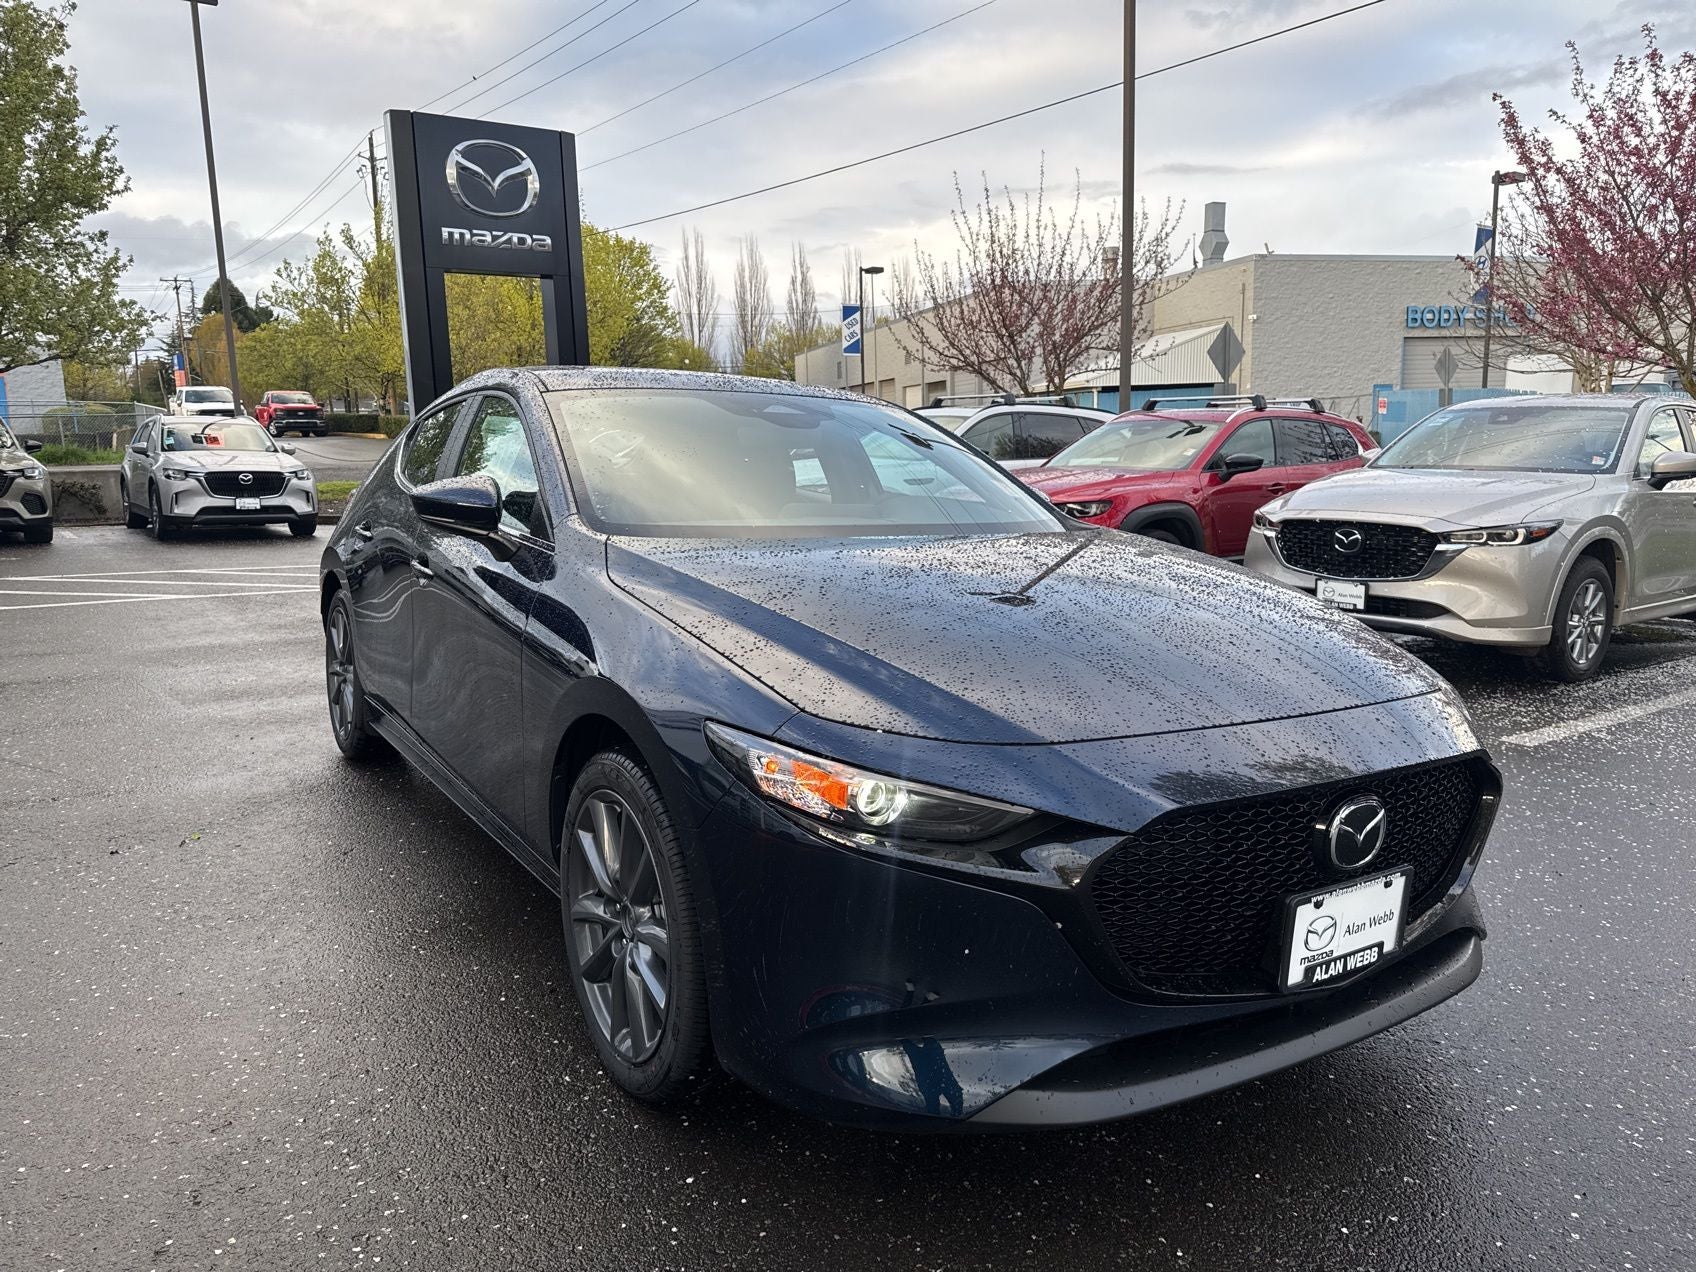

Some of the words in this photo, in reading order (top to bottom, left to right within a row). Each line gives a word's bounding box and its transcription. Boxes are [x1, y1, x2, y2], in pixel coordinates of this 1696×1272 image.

[441, 227, 553, 252] mazda
[844, 317, 859, 330] USED
[1406, 305, 1469, 329] BODY
[844, 330, 859, 342] CARS
[1343, 922, 1366, 938] Alan
[1369, 908, 1395, 929] Webb
[1300, 949, 1334, 966] mazda
[1312, 957, 1344, 983] ALAN
[1346, 946, 1379, 971] WEBB
